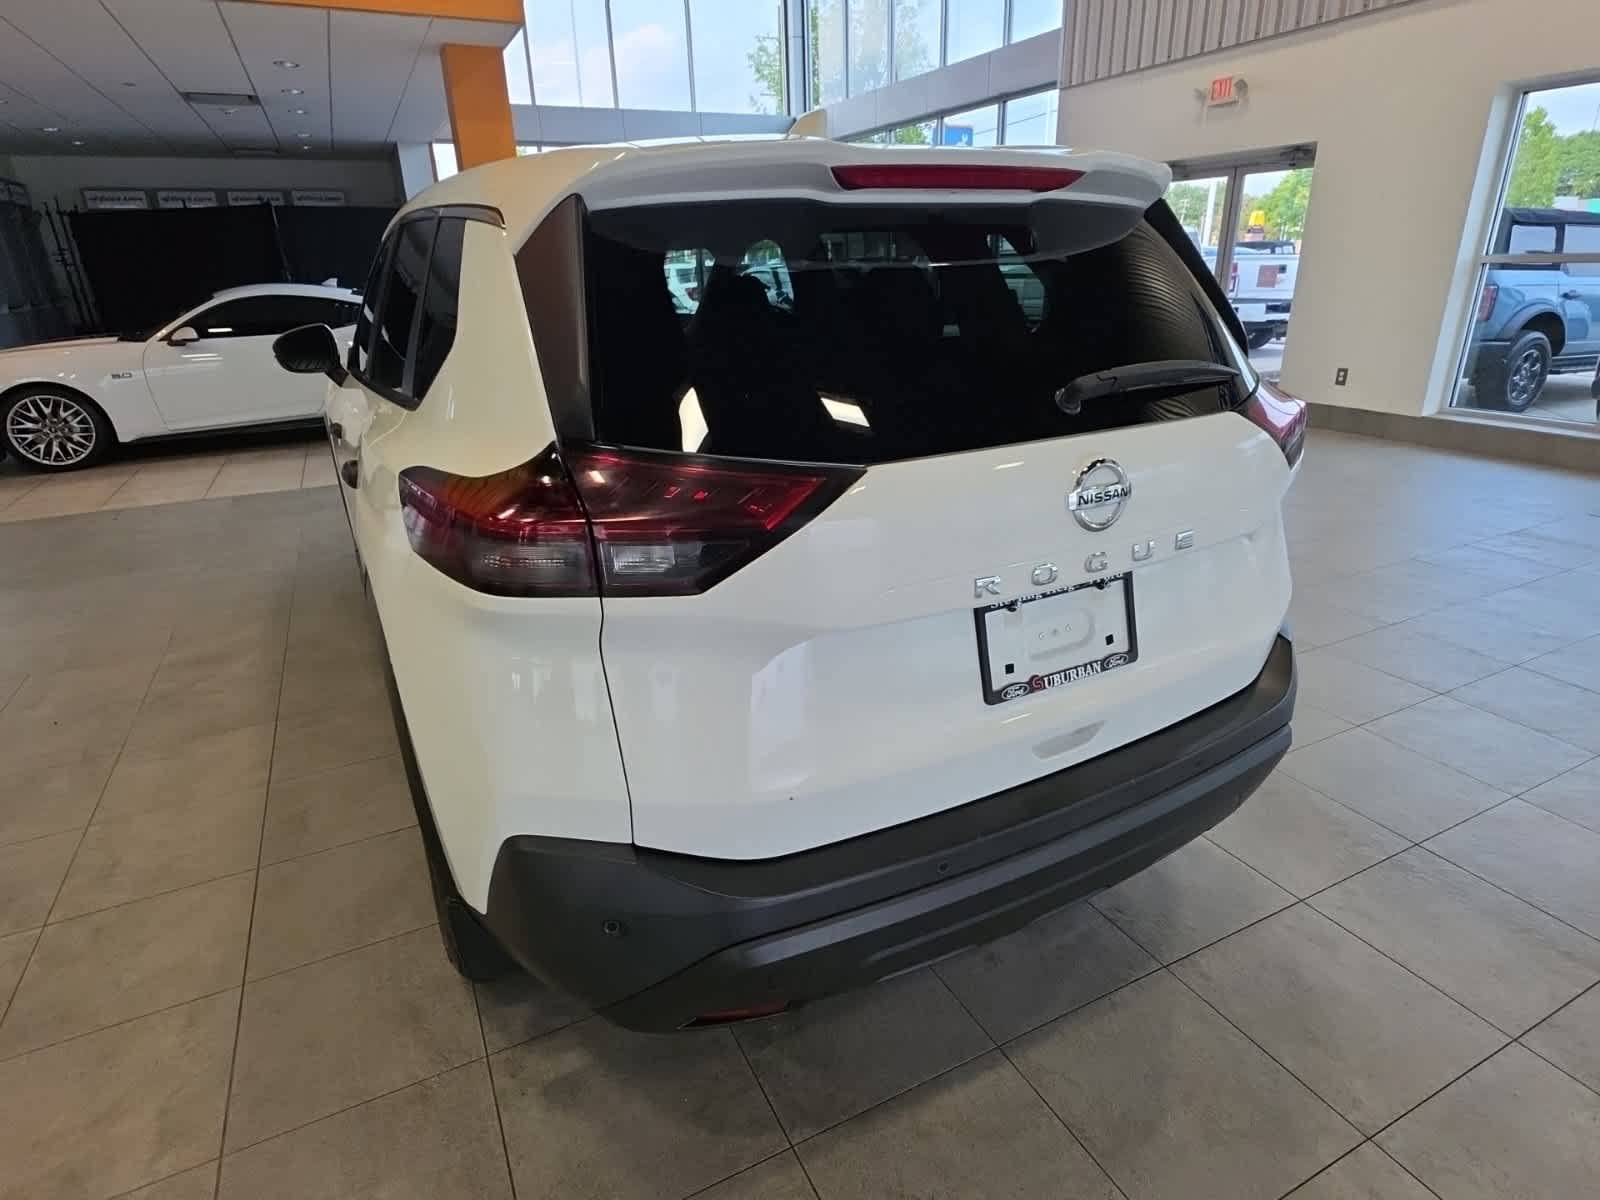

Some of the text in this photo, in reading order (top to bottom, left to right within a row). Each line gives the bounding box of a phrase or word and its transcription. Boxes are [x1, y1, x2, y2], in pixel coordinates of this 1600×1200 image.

[1077, 487, 1129, 506] NISSAN
[974, 530, 1194, 598] ROGUE
[1004, 654, 1127, 699] Ford SUBURBAN Ford
